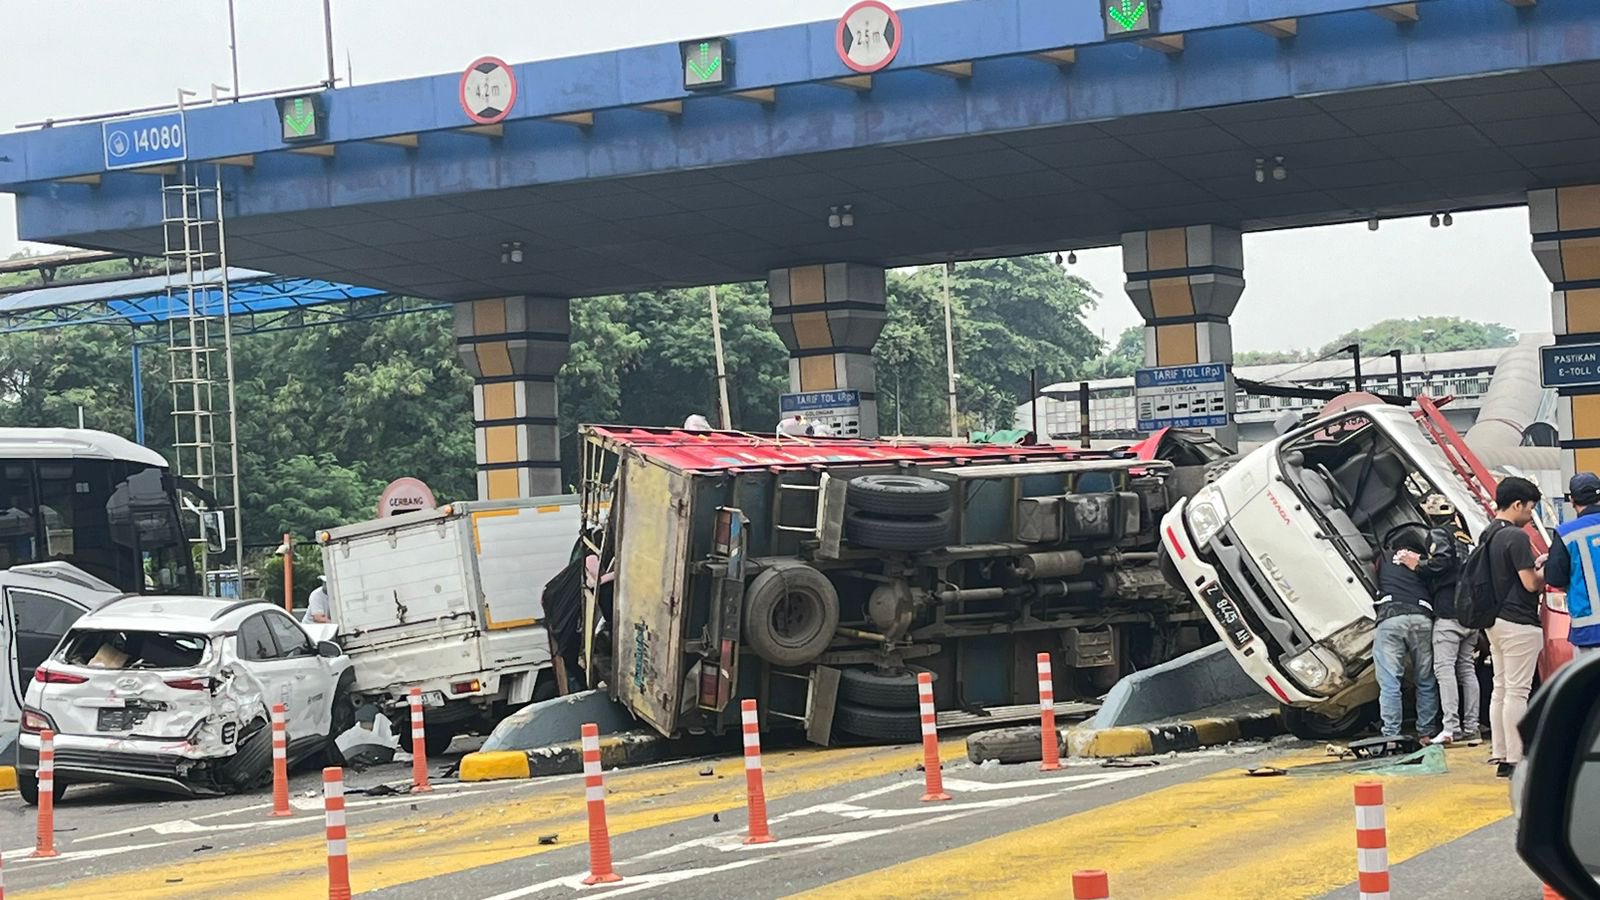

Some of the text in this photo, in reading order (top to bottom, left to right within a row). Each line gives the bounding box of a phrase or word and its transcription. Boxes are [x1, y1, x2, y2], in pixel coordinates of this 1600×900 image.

[133, 124, 181, 153] 14080
[1554, 353, 1596, 364] PASTIKAN
[1153, 366, 1220, 380] TARIF TOL (Rp)
[1558, 366, 1592, 377] E-TOLL
[796, 394, 818, 405] TARIF
[820, 393, 836, 403] TOL
[1266, 489, 1290, 525] TRAGA
[1259, 552, 1300, 604] ISUZU
[1206, 584, 1219, 596] Z
[1216, 598, 1238, 624] 8445
[1235, 629, 1250, 644] AH
